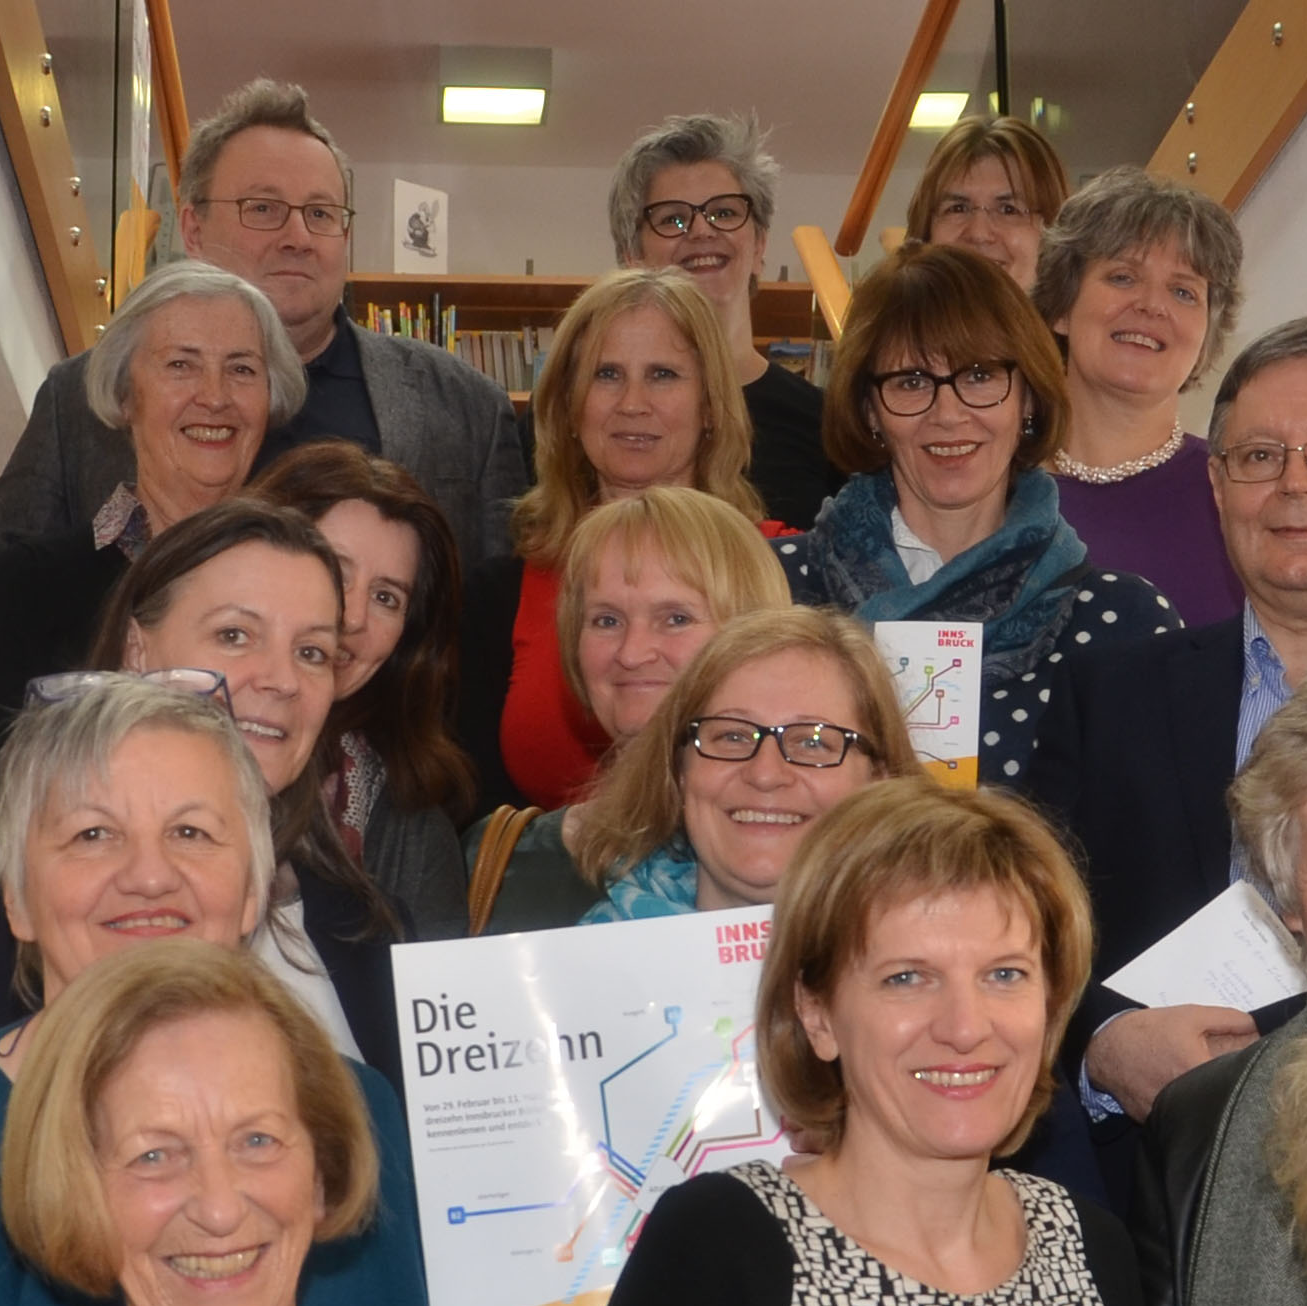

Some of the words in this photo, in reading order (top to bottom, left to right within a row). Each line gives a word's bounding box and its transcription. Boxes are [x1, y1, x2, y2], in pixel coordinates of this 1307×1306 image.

[938, 630, 966, 638] INNS'
[938, 639, 974, 647] BRUCK
[715, 920, 772, 943] INNS
[718, 942, 767, 964] BRU
[412, 994, 477, 1034] Die
[457, 1097, 492, 1109] Februar
[425, 1113, 464, 1125] dreizehn
